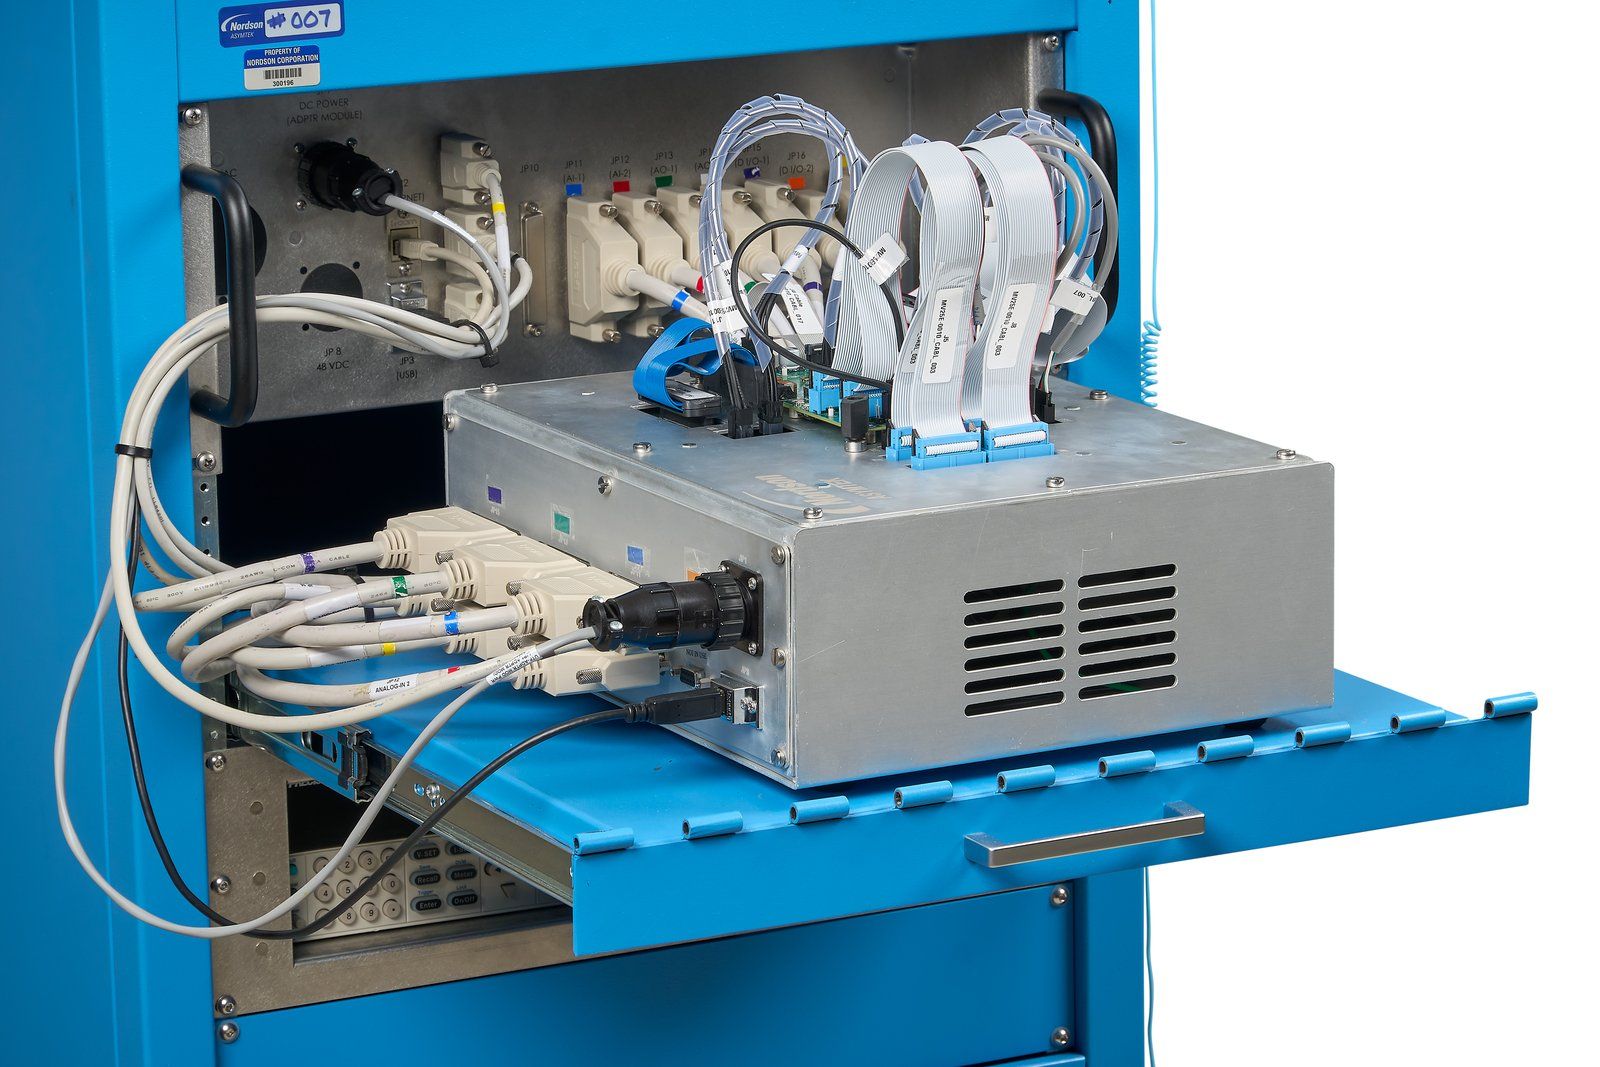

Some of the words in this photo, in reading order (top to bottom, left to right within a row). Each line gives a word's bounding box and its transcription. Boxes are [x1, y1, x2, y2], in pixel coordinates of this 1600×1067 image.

[230, 20, 264, 32] Nordson
[264, 47, 293, 56] PROPERTY
[293, 46, 301, 54] OF
[246, 58, 276, 67] NORDSON
[277, 54, 319, 64] CORPORATION
[272, 79, 294, 88] 300196
[299, 101, 313, 110] DC
[316, 97, 349, 109] POWER
[320, 109, 363, 122] MODULE)
[610, 155, 630, 165] JP12
[654, 151, 674, 161] JP13
[788, 151, 806, 161] JP16
[519, 163, 540, 174] JP10
[564, 159, 583, 169] JP11
[942, 335, 950, 343] J5
[336, 347, 342, 355] 8
[317, 363, 327, 371] 48
[329, 360, 350, 370] VDC
[400, 356, 415, 366] JP3
[396, 369, 418, 381] (USB)
[329, 554, 350, 562] CABLE
[375, 682, 406, 694] ANALOG-IN
[345, 861, 350, 869] 2
[367, 857, 373, 866] 3
[390, 880, 396, 888] 0
[417, 875, 439, 884] Recall
[345, 886, 351, 894] 5
[420, 902, 438, 910] Enter
[346, 912, 352, 920] 8
[368, 909, 374, 917] 9
